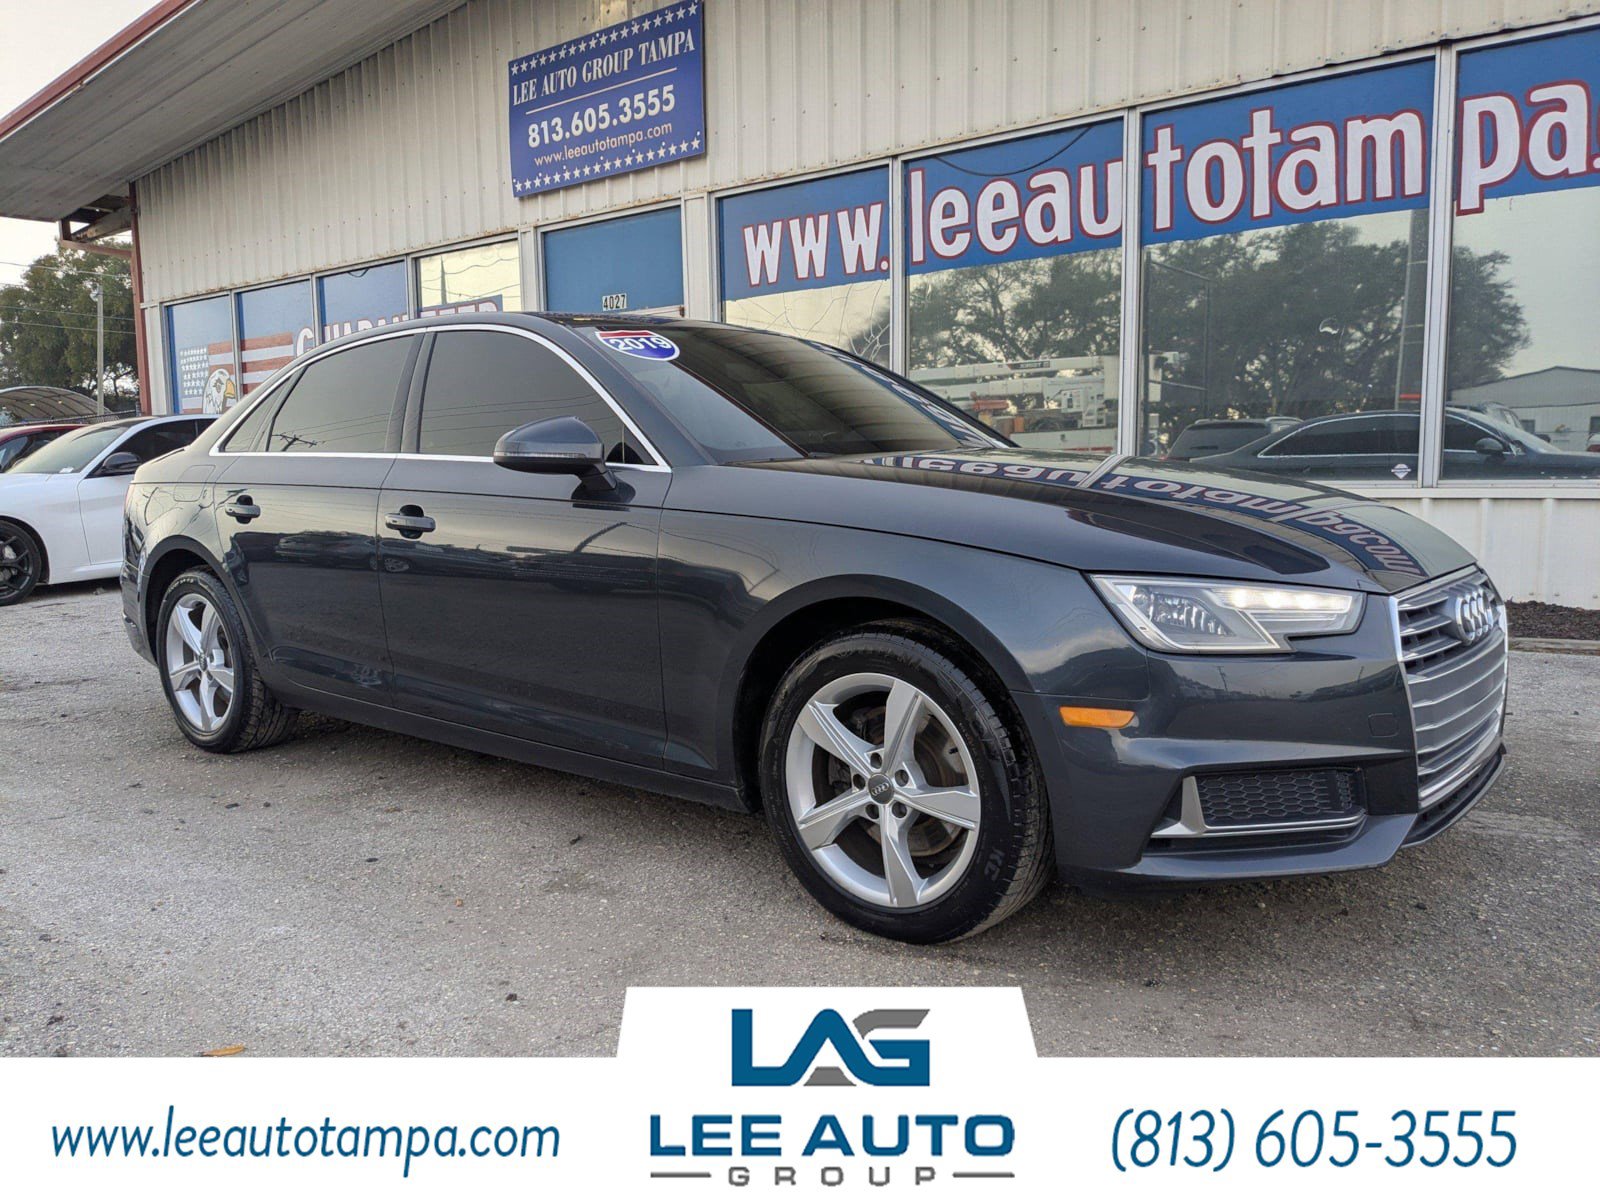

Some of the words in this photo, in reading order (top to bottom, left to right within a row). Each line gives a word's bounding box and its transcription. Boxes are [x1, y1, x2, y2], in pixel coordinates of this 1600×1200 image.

[513, 78, 537, 106] LEE
[541, 65, 577, 97] AUTO
[582, 47, 633, 84] GROUP
[638, 28, 695, 66] TAMPA
[528, 84, 675, 148] 813.605.3555
[534, 121, 672, 167] www.leeautotampa.com
[603, 294, 626, 310] 4027
[608, 337, 672, 351] 2019
